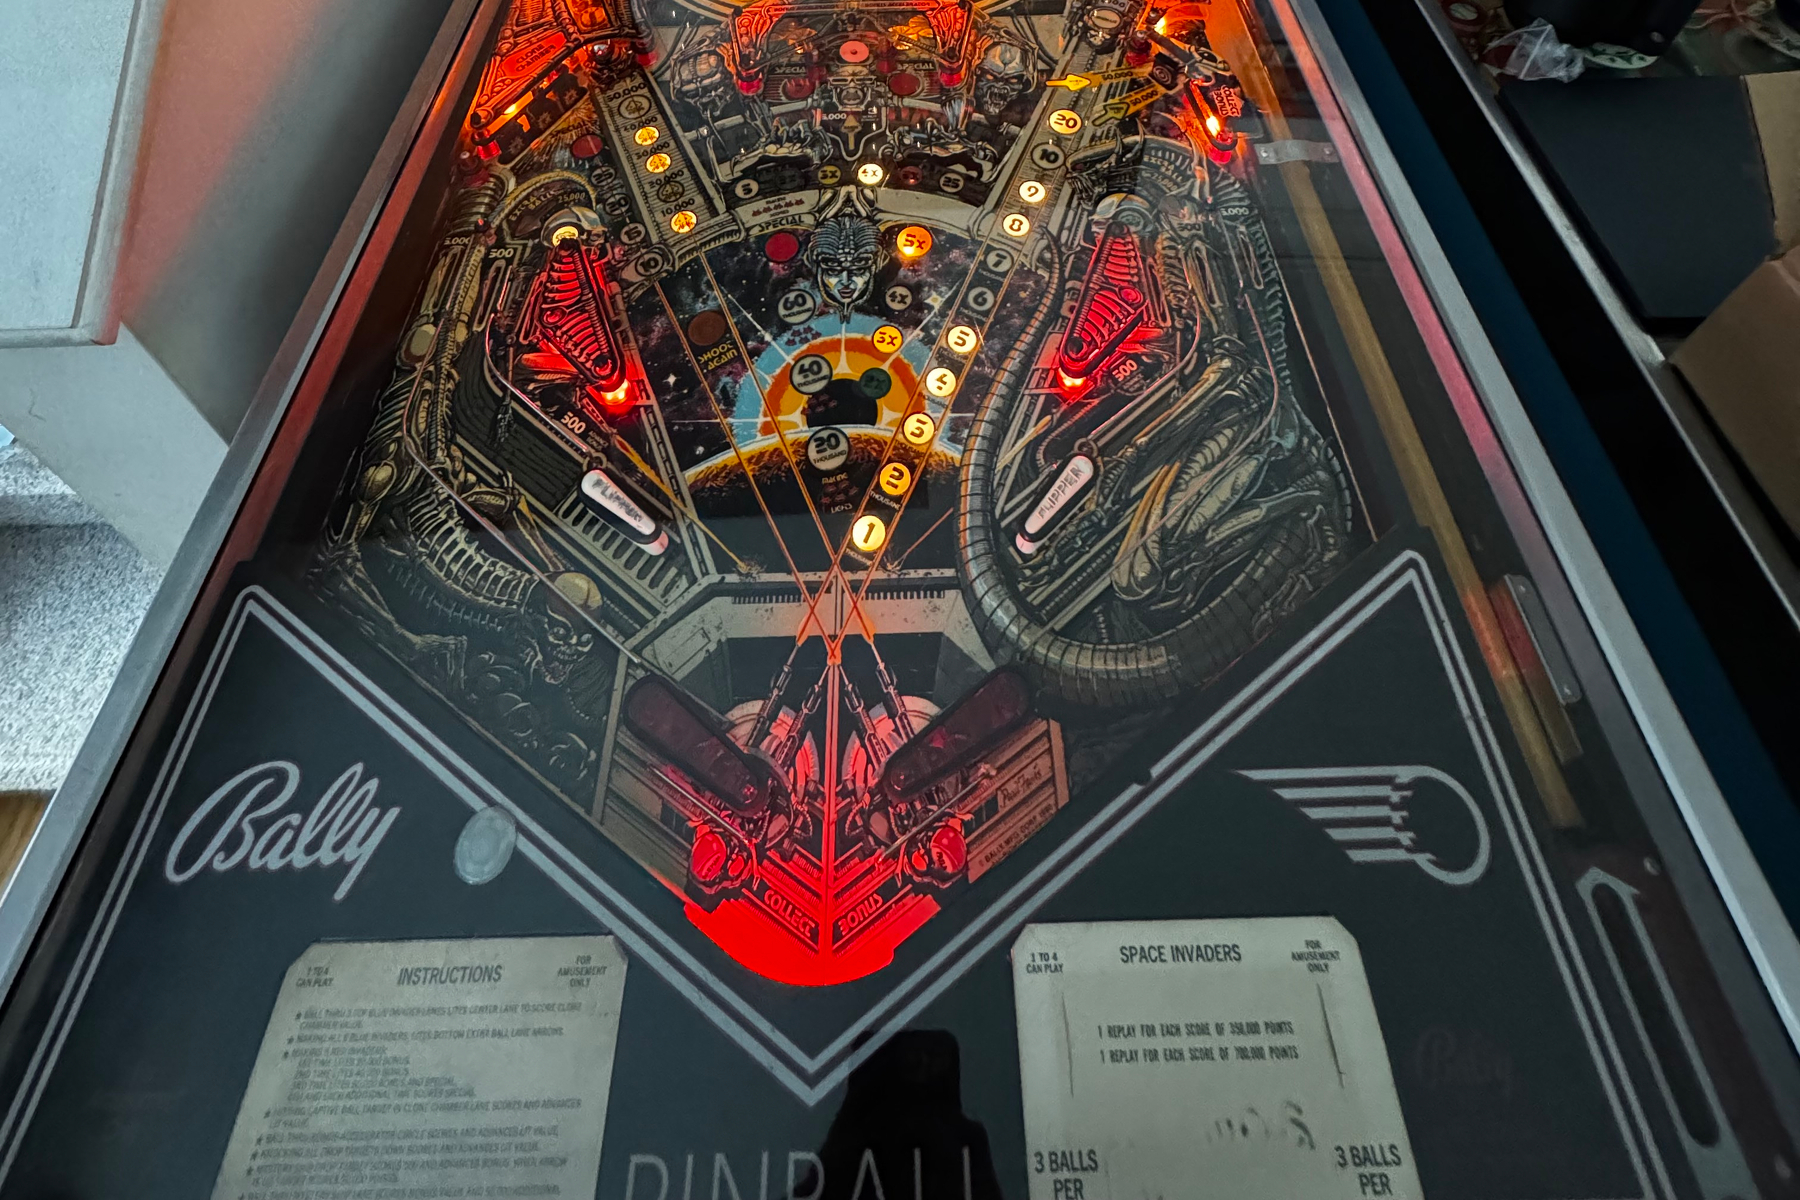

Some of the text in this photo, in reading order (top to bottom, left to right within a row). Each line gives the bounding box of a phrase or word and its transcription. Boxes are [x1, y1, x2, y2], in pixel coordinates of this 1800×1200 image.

[516, 43, 546, 64] CLONE
[1054, 113, 1079, 128] 20
[1041, 148, 1057, 164] 10
[1025, 185, 1040, 199] 9
[758, 215, 805, 233] SPECIAL
[1008, 217, 1024, 233] 8
[903, 234, 928, 251] 5X
[991, 252, 1008, 269] 7
[782, 293, 807, 312] 60
[972, 290, 989, 307] 6
[952, 329, 971, 349] 5
[1111, 359, 1138, 382] 500
[935, 373, 949, 392] 4
[561, 411, 587, 435] 500
[813, 432, 841, 454] 20
[886, 465, 906, 490] 2
[1036, 464, 1086, 520] FLIPPER
[862, 522, 877, 545] 1
[164, 760, 400, 902] Bally
[763, 889, 884, 938] COLLECT BONUS
[1038, 953, 1050, 962] TO
[1119, 944, 1242, 964] SPACE INVADERS
[1291, 950, 1341, 962] AMUSEMENT
[397, 964, 503, 987] INSTRUCTIONS
[1026, 963, 1064, 974] CAN PLAY
[1307, 962, 1330, 973] ONLY
[1107, 1024, 1136, 1039] REPLAY
[1141, 1023, 1157, 1038] FOR
[1264, 1020, 1293, 1035] POINTS
[1110, 1049, 1139, 1064] REPLAY
[1143, 1048, 1159, 1063] FOR
[1269, 1046, 1299, 1061] POINTS
[1034, 1149, 1098, 1173] 3 BALLS
[1334, 1143, 1402, 1168] 3 BALLS
[1052, 1179, 1085, 1200] PER
[1358, 1173, 1393, 1196] PER
